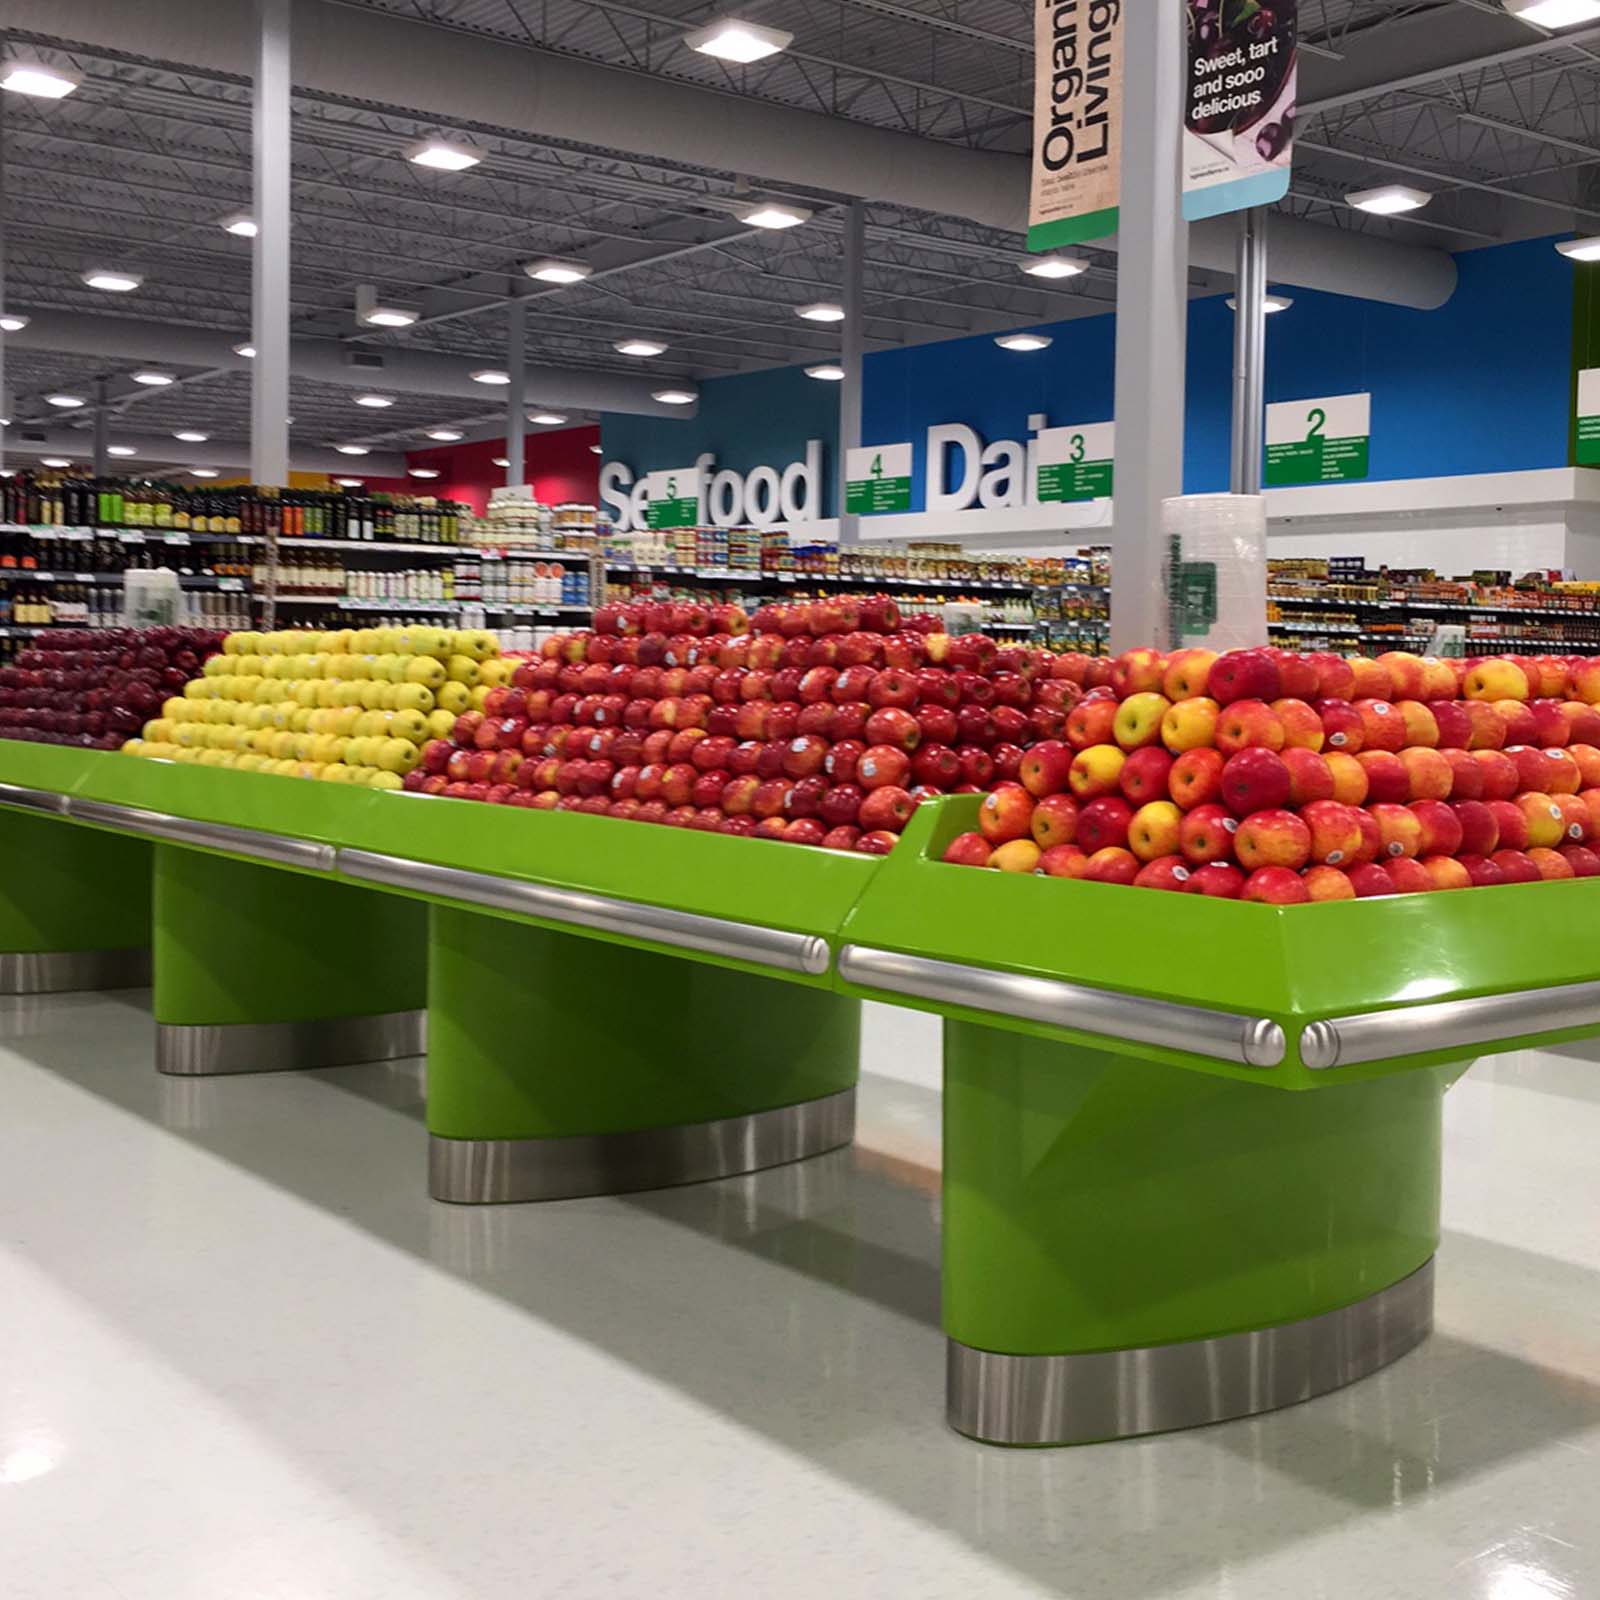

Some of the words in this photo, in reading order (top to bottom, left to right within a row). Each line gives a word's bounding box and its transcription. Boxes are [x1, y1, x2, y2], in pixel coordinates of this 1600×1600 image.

[1194, 47, 1246, 76] Sweet,
[1249, 36, 1278, 59] tart
[1076, 0, 1119, 163] Living
[1193, 74, 1222, 98] and
[1225, 66, 1265, 89] sooo
[1192, 90, 1261, 119] delicious
[1306, 408, 1326, 441] 2
[1070, 433, 1086, 464] 3
[870, 453, 883, 480] 4
[600, 440, 822, 530] Sefood
[666, 476, 677, 500] 5
